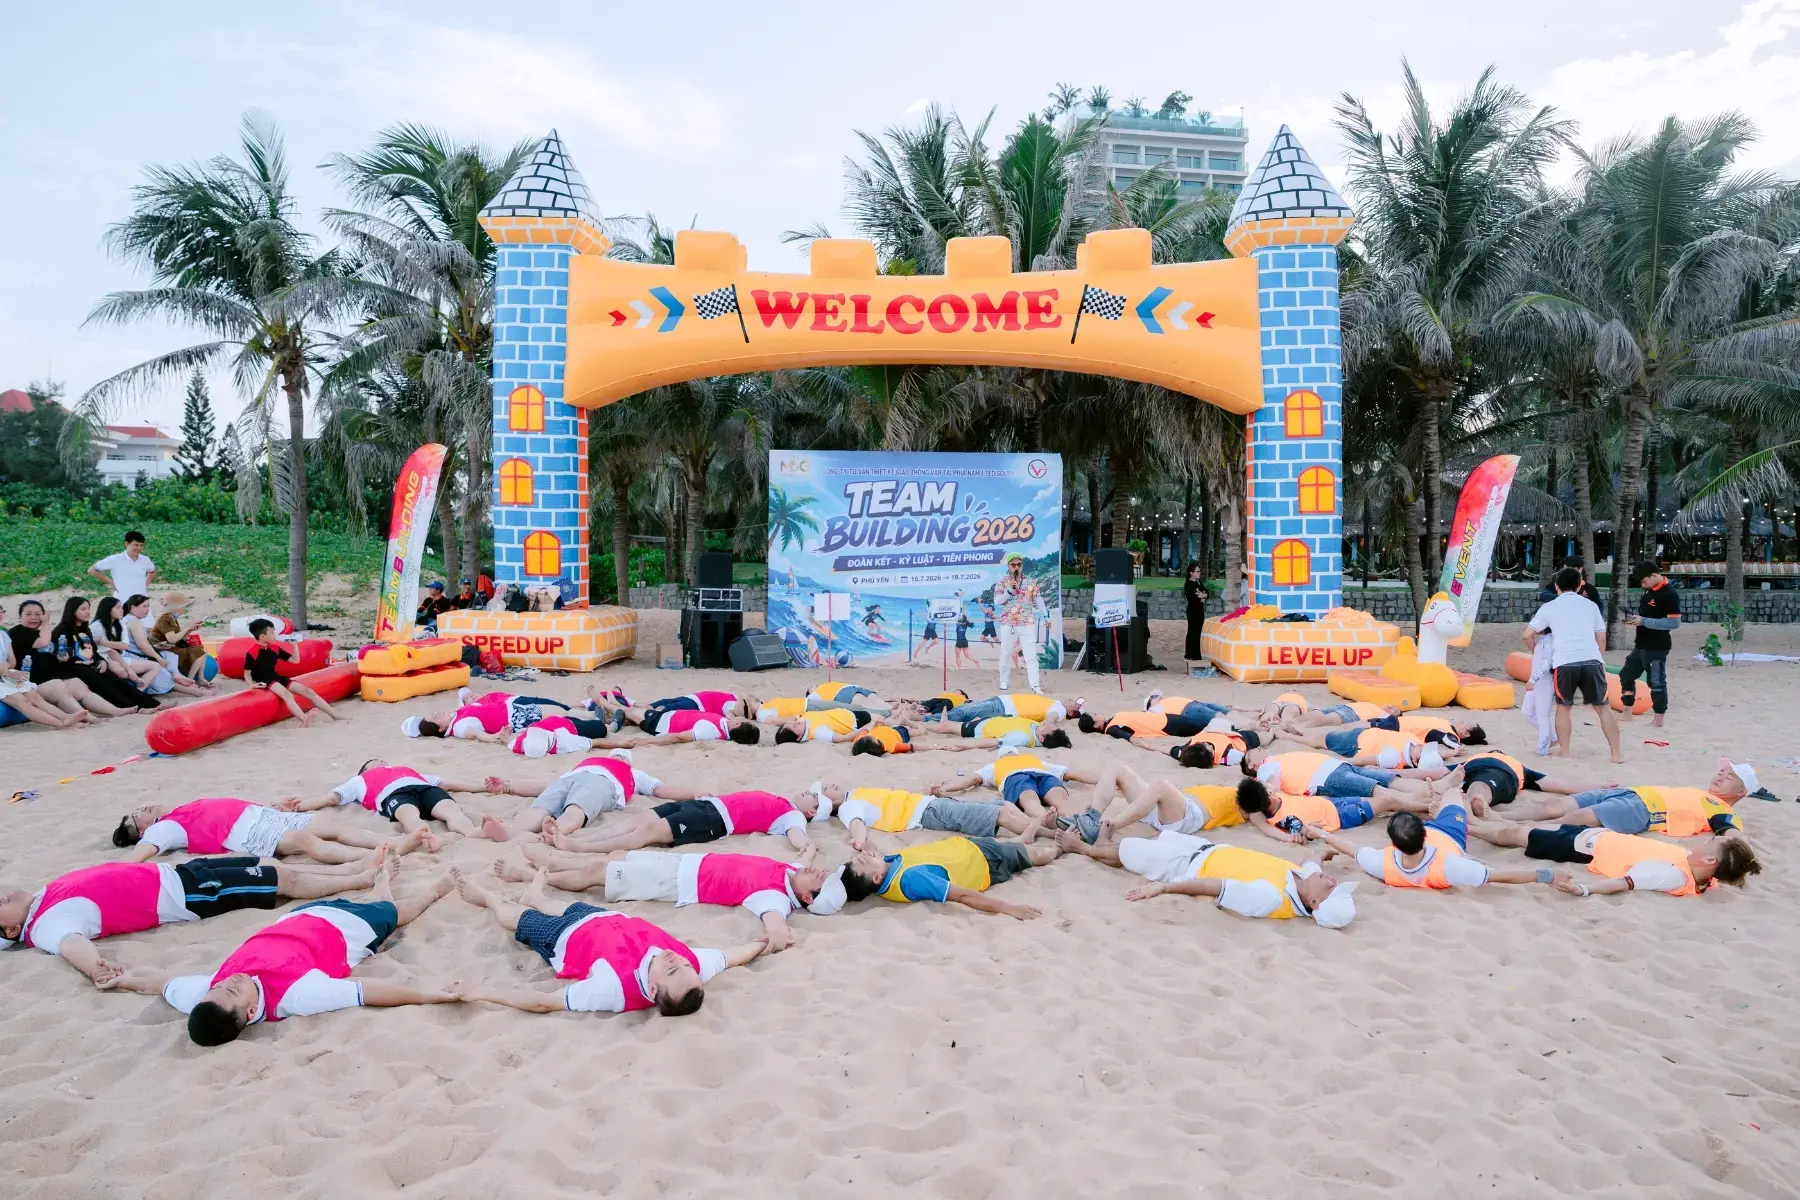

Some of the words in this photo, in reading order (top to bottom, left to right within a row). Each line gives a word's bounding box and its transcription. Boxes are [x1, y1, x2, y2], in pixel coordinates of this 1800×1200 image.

[750, 288, 1062, 334] WELCOME
[968, 469, 980, 477] NAM
[845, 481, 957, 517] TEAM
[382, 470, 419, 632] TEAMBUILDING
[817, 515, 971, 552] BUILDING
[972, 514, 1034, 547] 2026
[847, 557, 873, 568] ĐOÀN
[874, 555, 891, 566] KẾT
[912, 554, 934, 567] LUẬT
[942, 552, 961, 563] TIÊN
[963, 552, 994, 561] PHONG
[1450, 519, 1476, 598] EVENT
[461, 635, 530, 655] SPEED
[535, 636, 564, 654] UP
[1267, 646, 1337, 666] LEVEL
[1343, 648, 1373, 666] UP
